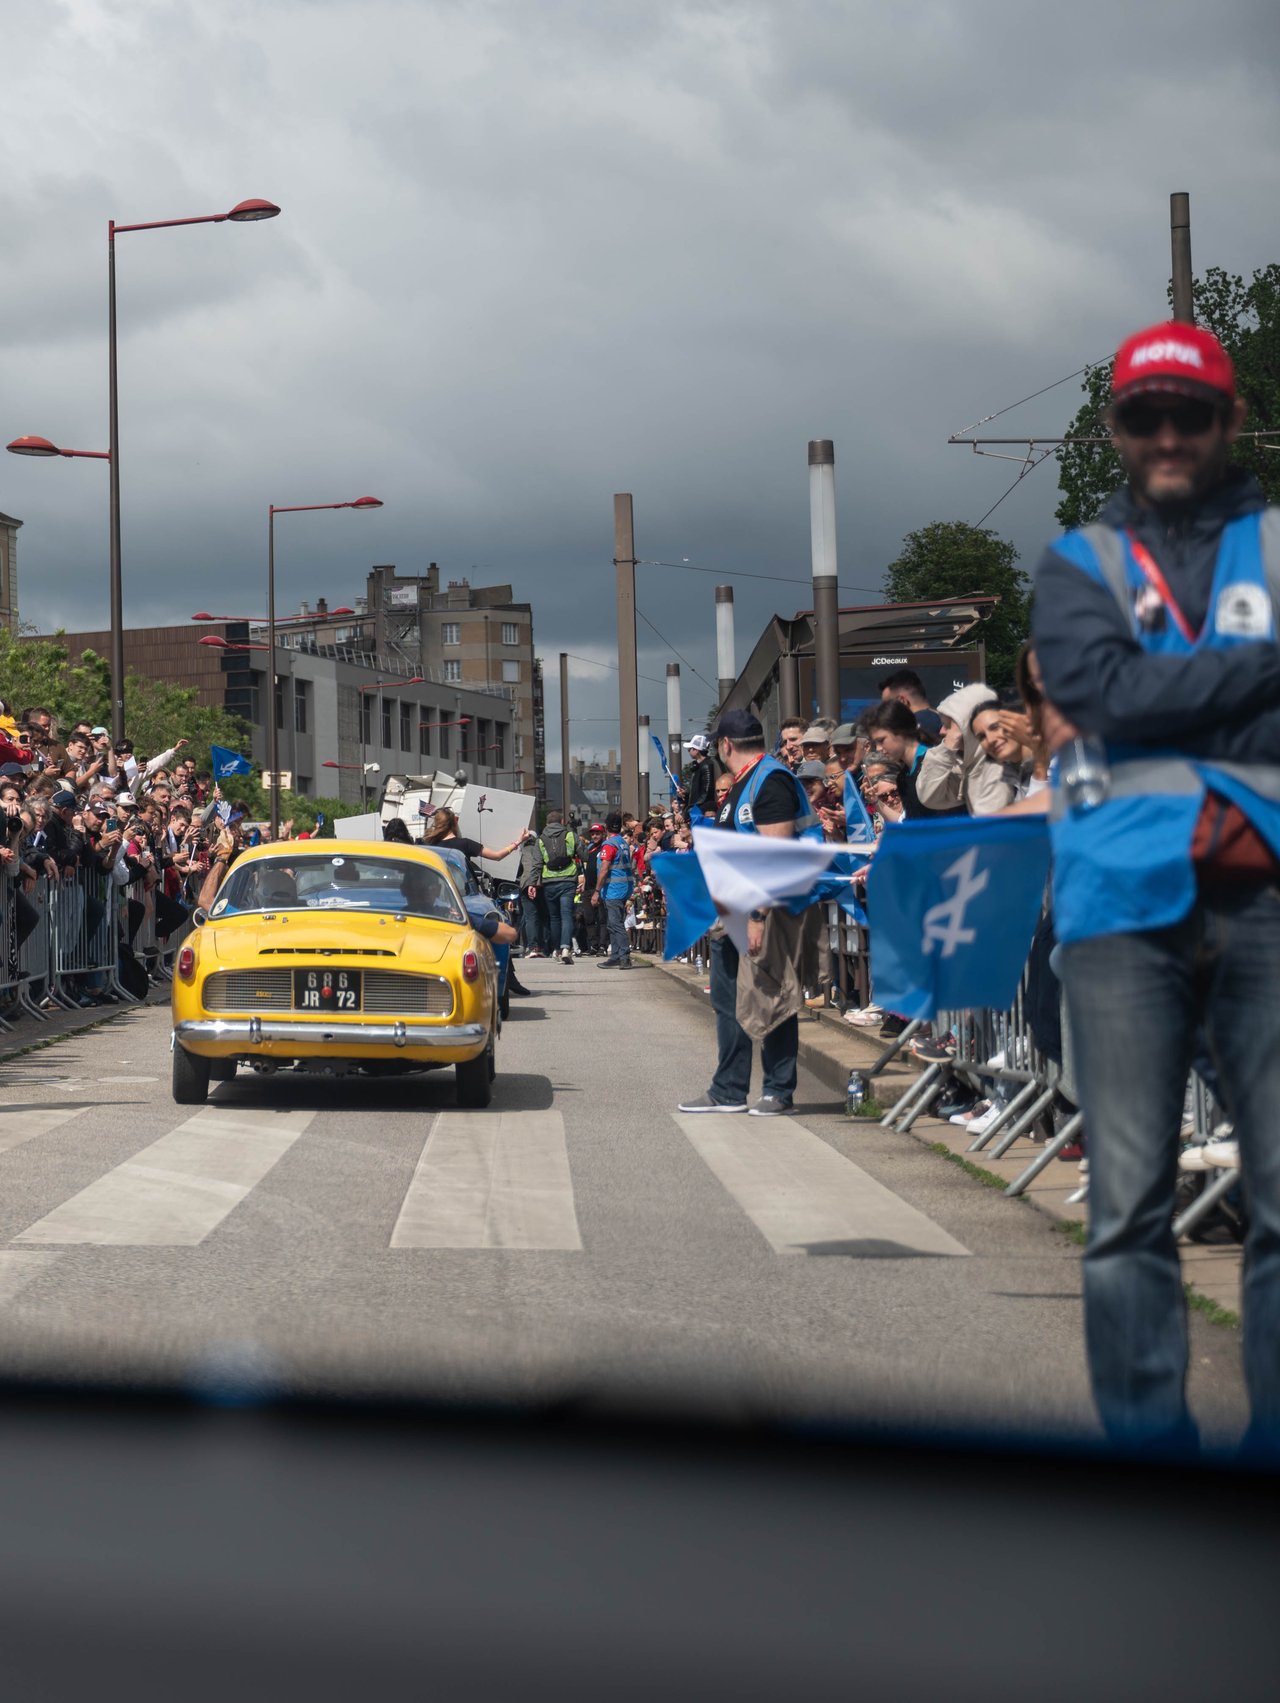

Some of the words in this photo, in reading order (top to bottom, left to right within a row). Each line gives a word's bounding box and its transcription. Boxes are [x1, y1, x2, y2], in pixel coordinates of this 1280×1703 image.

[871, 657, 908, 665] JCDecaux
[307, 972, 348, 989] 686
[302, 990, 320, 1008] JR
[336, 990, 355, 1008] 72
